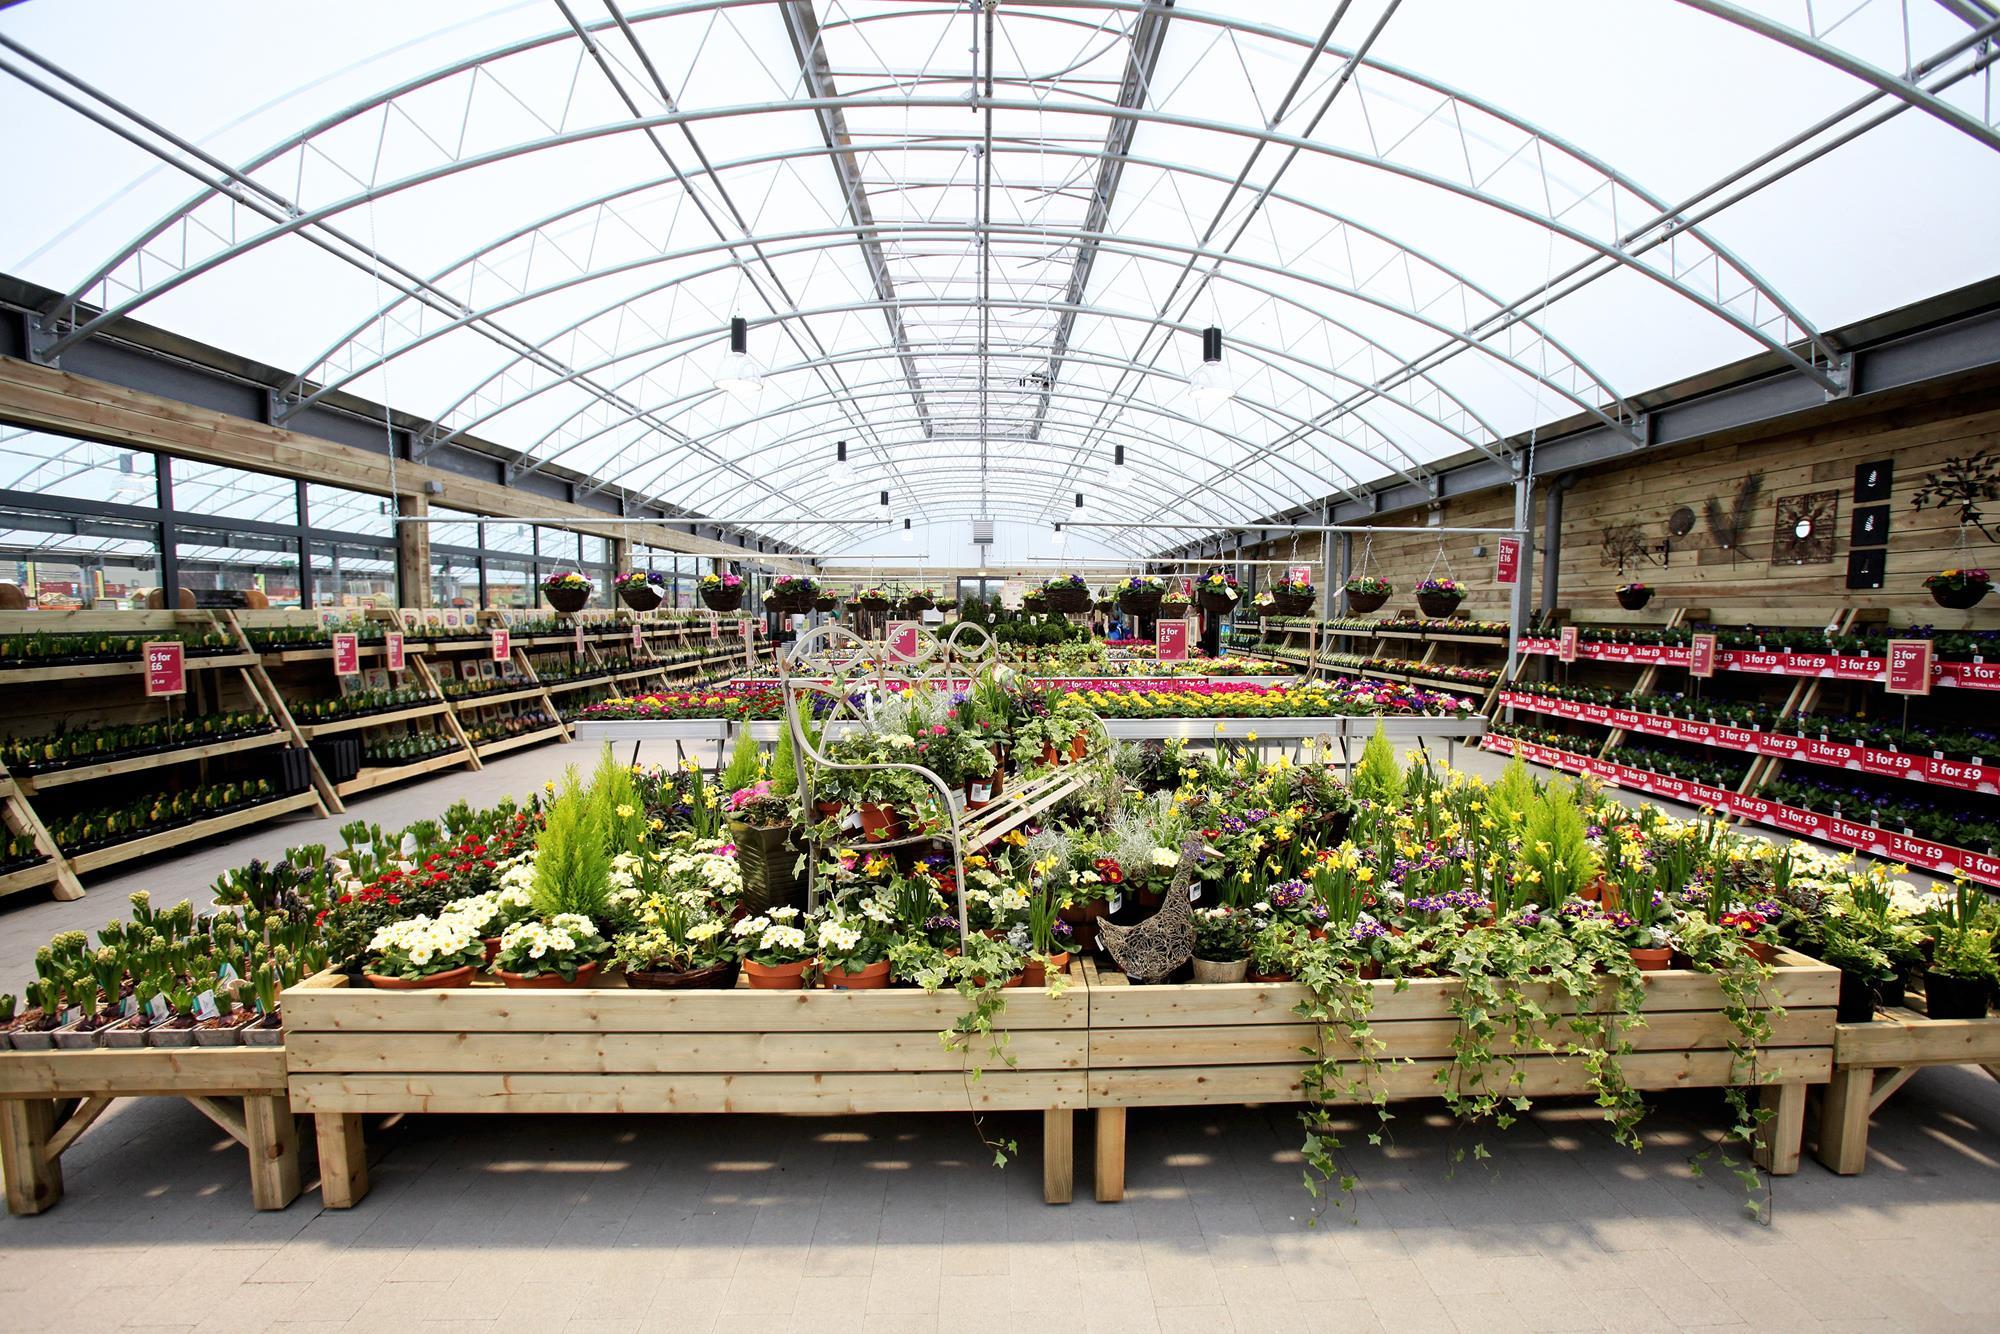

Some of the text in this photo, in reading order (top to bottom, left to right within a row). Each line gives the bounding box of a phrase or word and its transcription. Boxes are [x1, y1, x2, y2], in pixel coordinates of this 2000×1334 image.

[1612, 646, 1620, 654] for
[1641, 648, 1650, 656] for
[1674, 650, 1685, 658] for
[1894, 650, 1917, 660] 3 for
[158, 652, 171, 661] for
[1744, 655, 1776, 665] 3 for £9
[1790, 657, 1825, 668] 3 for £9
[152, 662, 162, 670] £6
[1840, 659, 1880, 671] 3 for £9
[1893, 660, 1906, 668] £9
[1963, 666, 1995, 679] 3 for
[1591, 708, 1599, 716] for
[1620, 713, 1629, 721] for
[1652, 718, 1662, 727] for
[1663, 720, 1672, 729] £9
[1682, 723, 1709, 736] 3 for £9
[1720, 730, 1750, 742] 3 for £9
[1763, 736, 1798, 750] 3 for £9
[1812, 743, 1850, 758] 3 for £9
[1866, 752, 1911, 768] 3 for £9
[1598, 763, 1607, 772] for
[1930, 762, 1982, 780] 3 for £9
[1628, 770, 1638, 780] for
[1638, 773, 1647, 782] £9
[1656, 778, 1683, 791] 3 for £9
[1693, 786, 1722, 800] 3 for £9
[1734, 796, 1768, 813] 3 for £9
[1780, 809, 1818, 826] 3 for £9
[1834, 822, 1876, 841] 3 for £9
[1894, 838, 1942, 859] 3 for £9
[1965, 856, 1999, 874] 3 for
